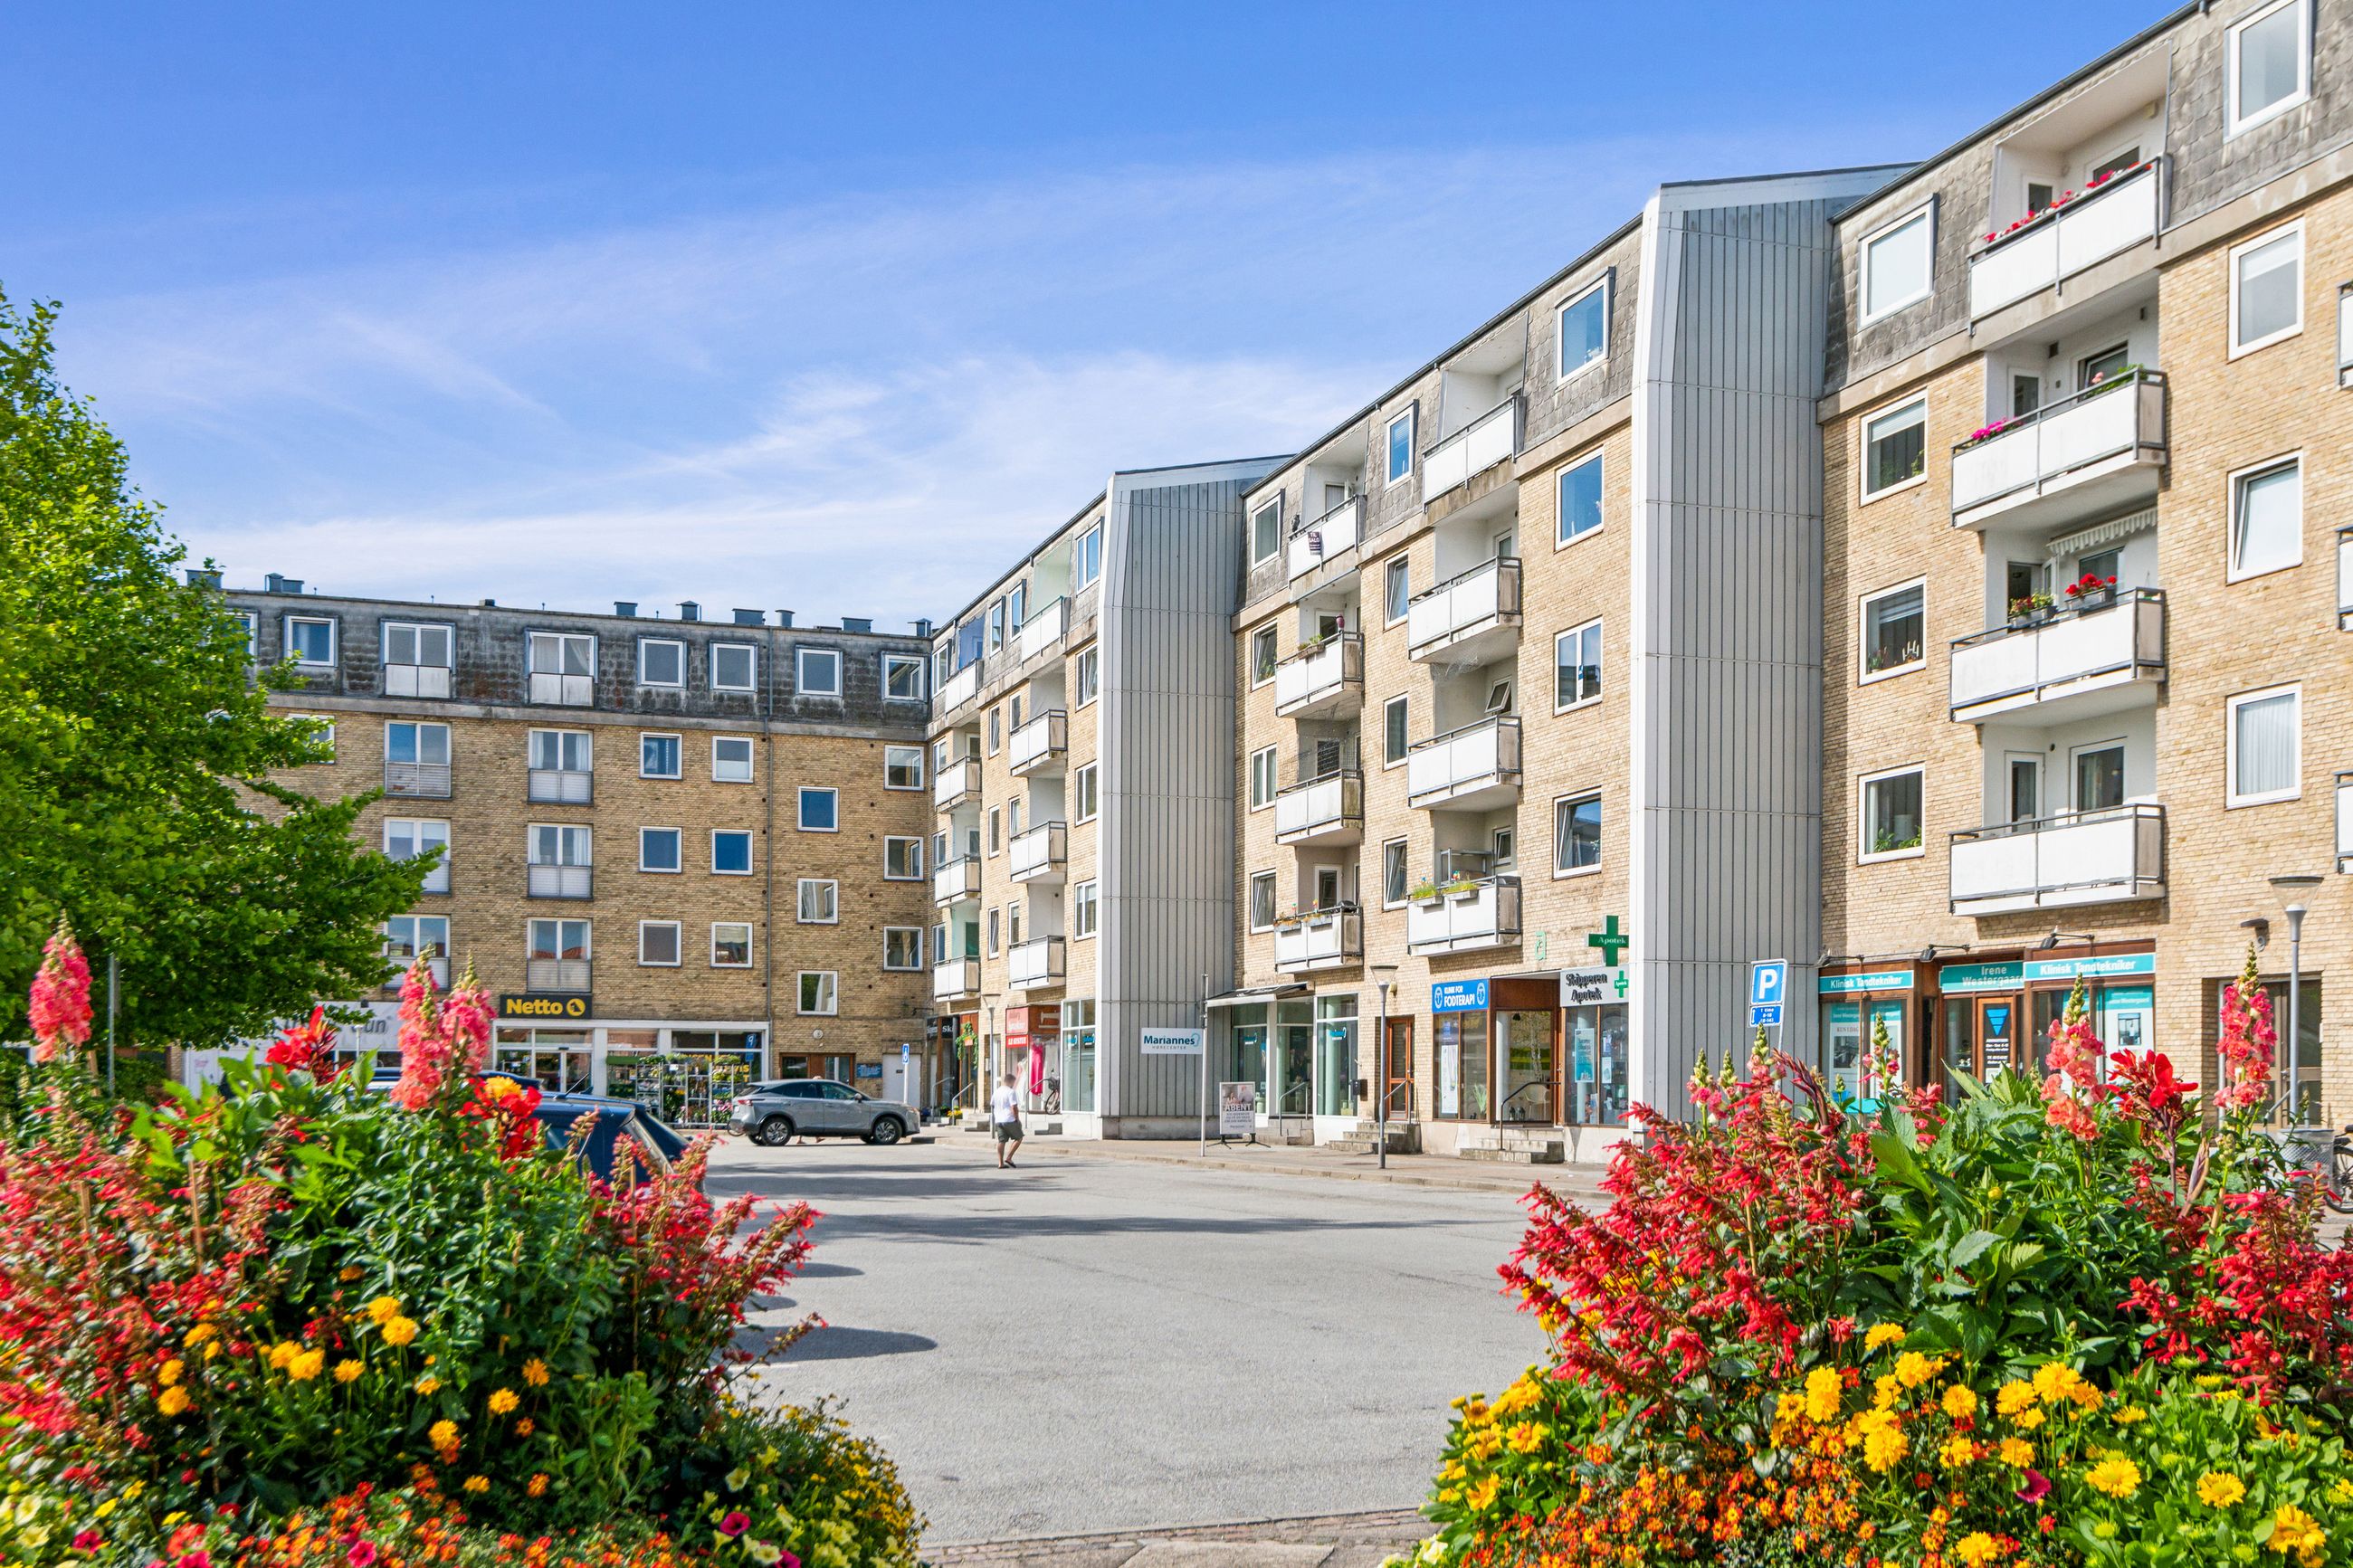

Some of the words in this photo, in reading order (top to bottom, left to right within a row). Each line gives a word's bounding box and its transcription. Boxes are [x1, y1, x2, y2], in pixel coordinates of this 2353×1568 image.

[1598, 936, 1626, 945] Apotek
[1981, 965, 2007, 975] Irene
[2040, 964, 2072, 975] Klinisk
[2074, 959, 2136, 974] Tandtekniker
[1566, 973, 1608, 989] Skipperen
[1758, 968, 1777, 999] P
[1830, 979, 1854, 989] Klinisk
[1856, 975, 1903, 987] Tandtekniker
[1443, 986, 1456, 994] KLINIK
[1571, 987, 1603, 1004] Apotek
[507, 998, 564, 1014] Netto
[1443, 993, 1475, 1007] FODTERAPI
[1143, 1035, 1195, 1045] Mariannes
